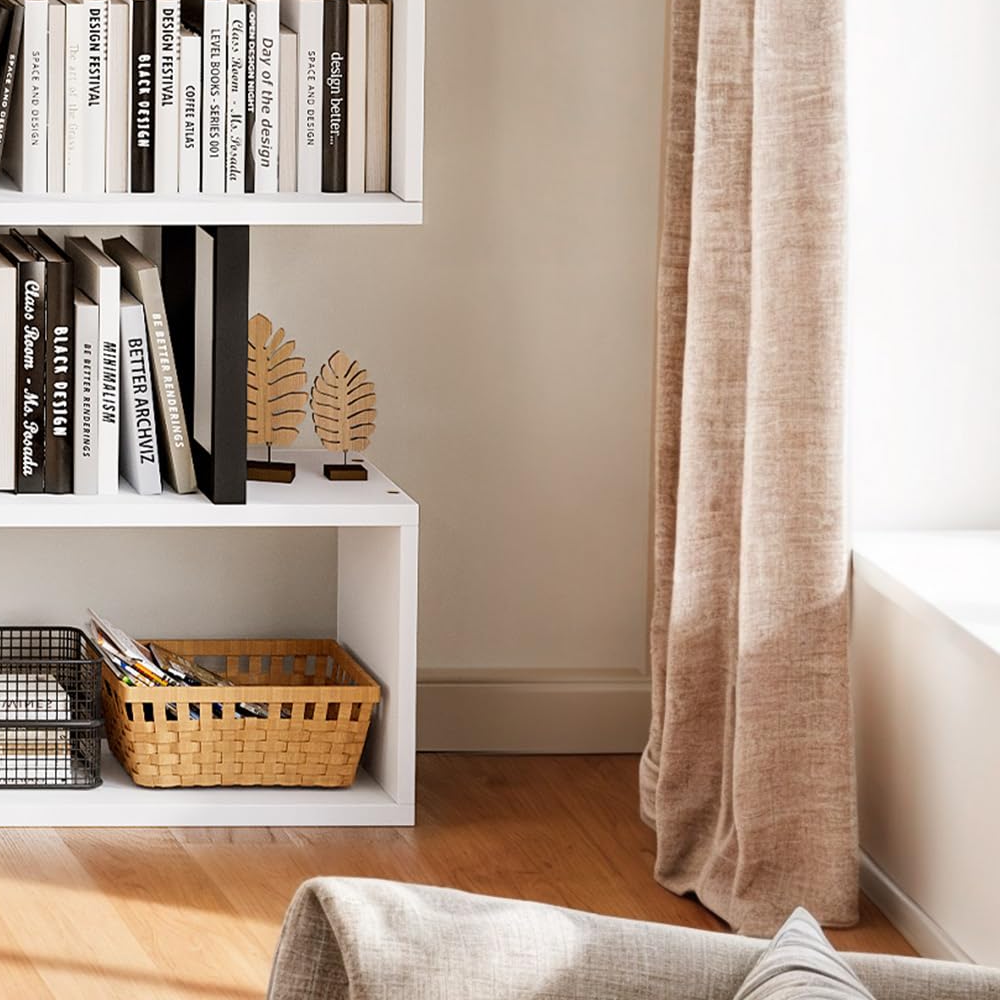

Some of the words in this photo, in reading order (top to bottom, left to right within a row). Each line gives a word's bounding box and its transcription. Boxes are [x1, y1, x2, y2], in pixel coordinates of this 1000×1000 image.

[90, 9, 100, 51] DESIGN
[162, 9, 174, 51] DESIGN
[211, 29, 220, 58] LEVEL
[232, 19, 244, 52] Class
[248, 11, 256, 39] OPEN
[5, 55, 15, 85] SPACE
[248, 41, 256, 79] DESIGN
[259, 38, 274, 68] Day
[307, 51, 315, 80] SPACE
[89, 56, 100, 106] FESTIVAL
[138, 55, 151, 94] BLACK
[162, 56, 173, 106] FESTIVAL
[211, 62, 220, 96] BOOKS
[231, 55, 243, 92] Room
[262, 71, 273, 87] of
[327, 52, 344, 94] design
[2, 87, 11, 107] AND
[185, 86, 195, 117] COFFEE
[247, 80, 255, 113] NIGHT
[260, 88, 274, 114] the
[307, 85, 315, 105] AND
[31, 110, 39, 145] DESIGN
[137, 101, 150, 147] DESIGN
[185, 121, 194, 148] ATLAS
[210, 105, 219, 138] SERIES
[209, 141, 219, 157] 001
[229, 136, 243, 181] Posada
[259, 118, 273, 167] design
[24, 280, 40, 320] Class
[152, 313, 162, 328] BE
[24, 326, 39, 369] Room
[54, 327, 68, 373] BLACK
[84, 344, 91, 355] BE
[155, 330, 171, 373] BETTER
[103, 342, 116, 423] MINIMALISM
[128, 339, 146, 395] BETTER
[24, 388, 38, 416] Ms.
[53, 382, 68, 435] DESIGN
[163, 375, 184, 448] RENDERINGS
[23, 420, 38, 476] Posada
[134, 397, 155, 464] ARCHVIZ
